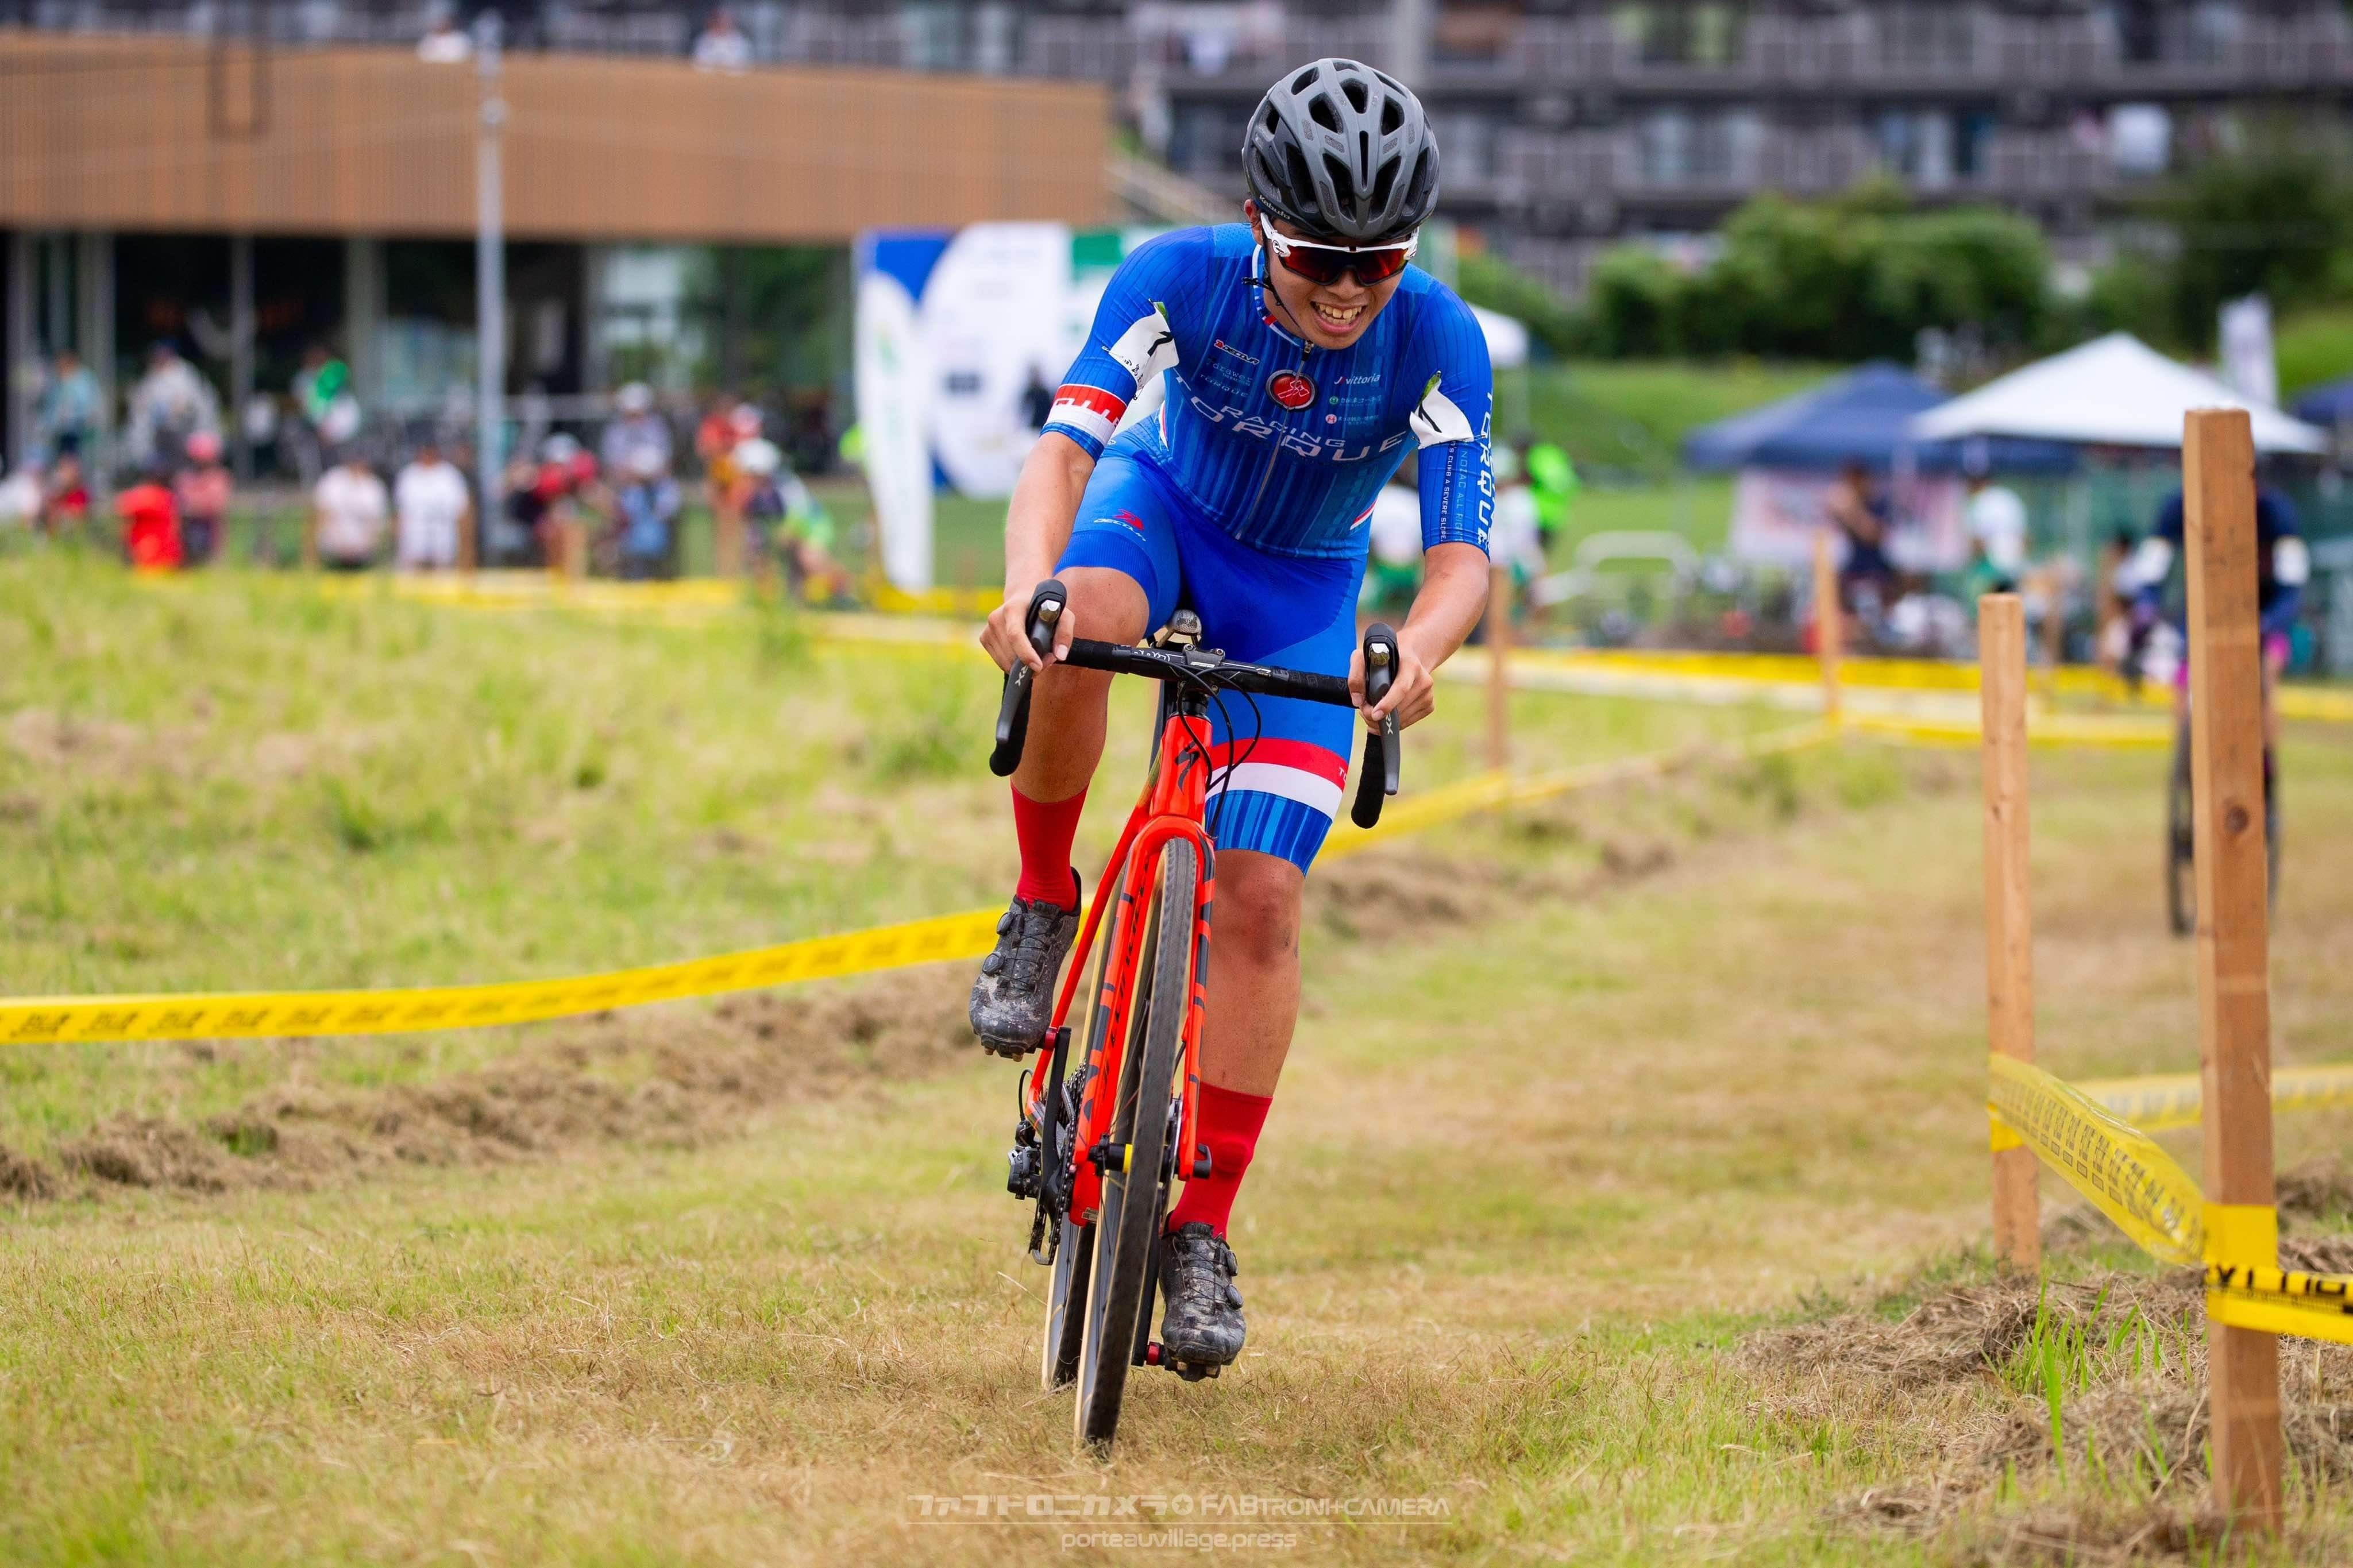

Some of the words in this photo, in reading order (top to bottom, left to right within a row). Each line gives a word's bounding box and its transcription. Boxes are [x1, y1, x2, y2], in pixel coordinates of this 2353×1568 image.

[1259, 195, 1290, 219] Kabuto
[1346, 373, 1381, 384] vittoria
[1221, 405, 1346, 447] RACING
[1441, 486, 1449, 515] SEVERE
